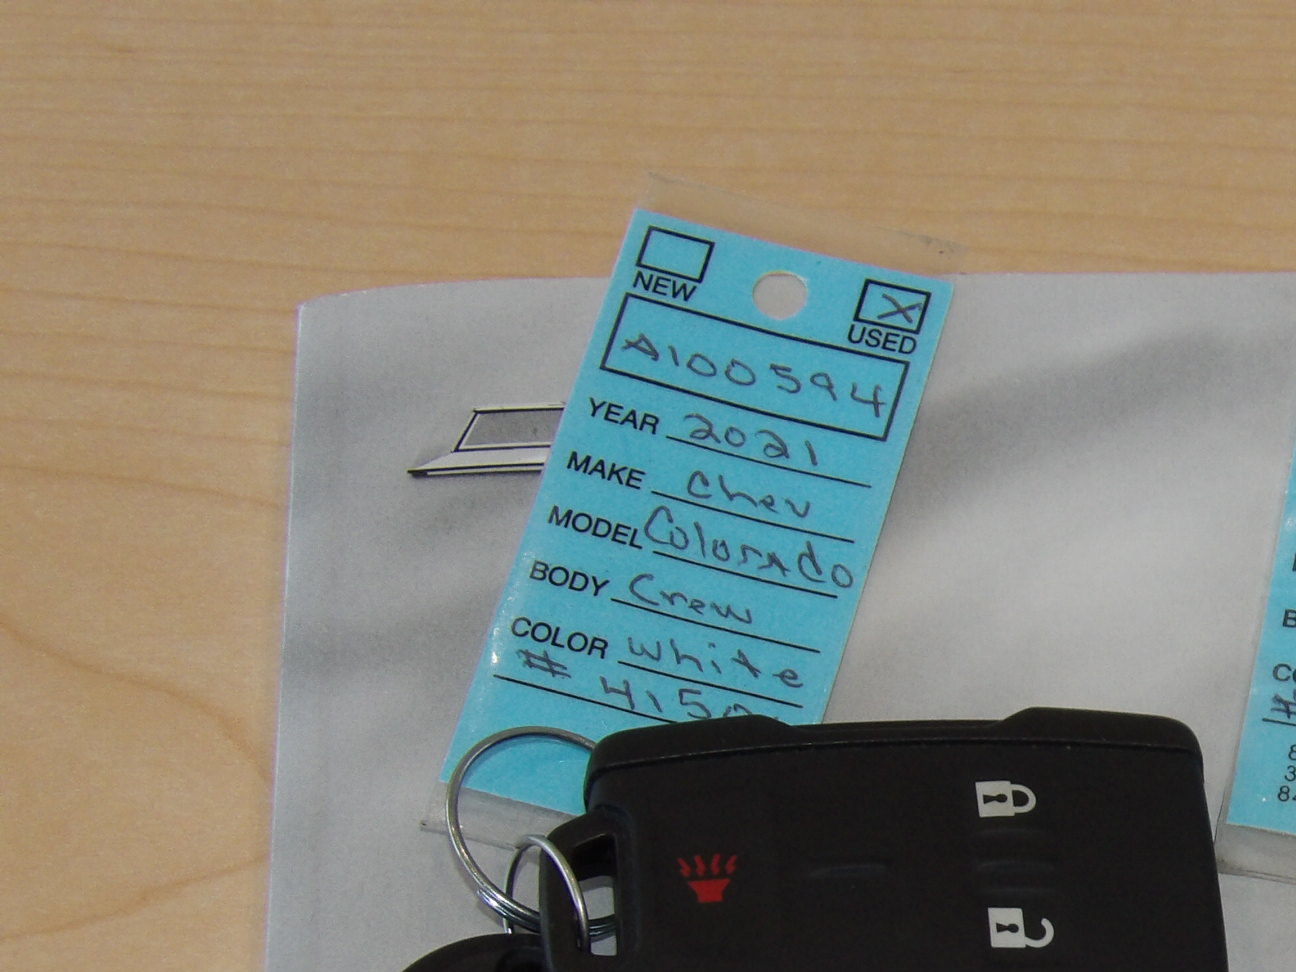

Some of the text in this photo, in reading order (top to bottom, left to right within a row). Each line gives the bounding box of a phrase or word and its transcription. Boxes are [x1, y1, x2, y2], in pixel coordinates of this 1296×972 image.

[632, 270, 919, 356] NEW USED
[621, 332, 886, 419] A100594
[588, 397, 819, 468] YEAR 2021
[566, 451, 646, 492] MAKE
[547, 505, 854, 589] MODEL Colorado
[528, 560, 611, 598] BODY
[510, 616, 609, 660] COLOR
[518, 648, 572, 680] #
